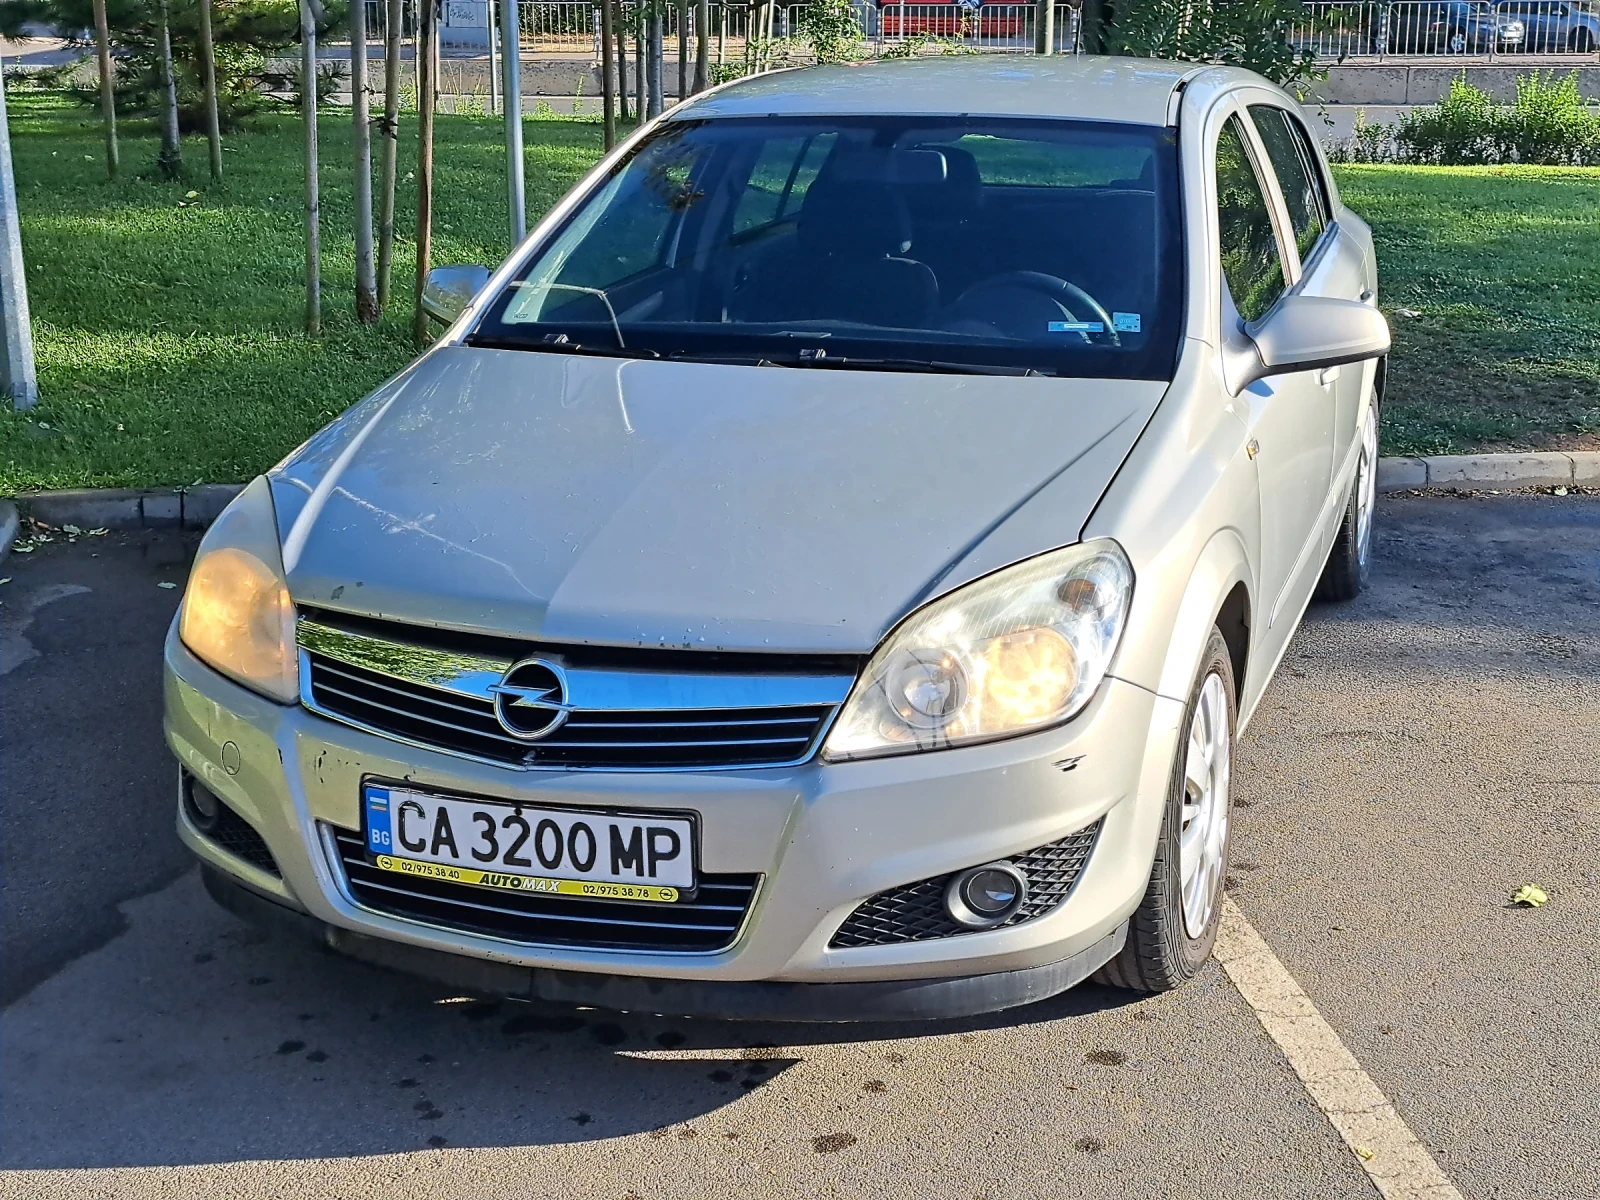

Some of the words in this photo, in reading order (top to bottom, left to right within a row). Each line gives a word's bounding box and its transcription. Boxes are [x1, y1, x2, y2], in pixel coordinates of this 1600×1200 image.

[371, 828, 390, 846] BG
[398, 801, 459, 858] CA
[471, 811, 597, 872] 3200
[609, 824, 681, 878] MP
[401, 862, 433, 875] 02/975
[435, 868, 446, 877] 38
[448, 870, 460, 879] 40
[478, 873, 561, 893] AUTOMAX
[583, 885, 619, 896] 02/975
[621, 887, 634, 897] 38
[637, 889, 649, 898] 78
